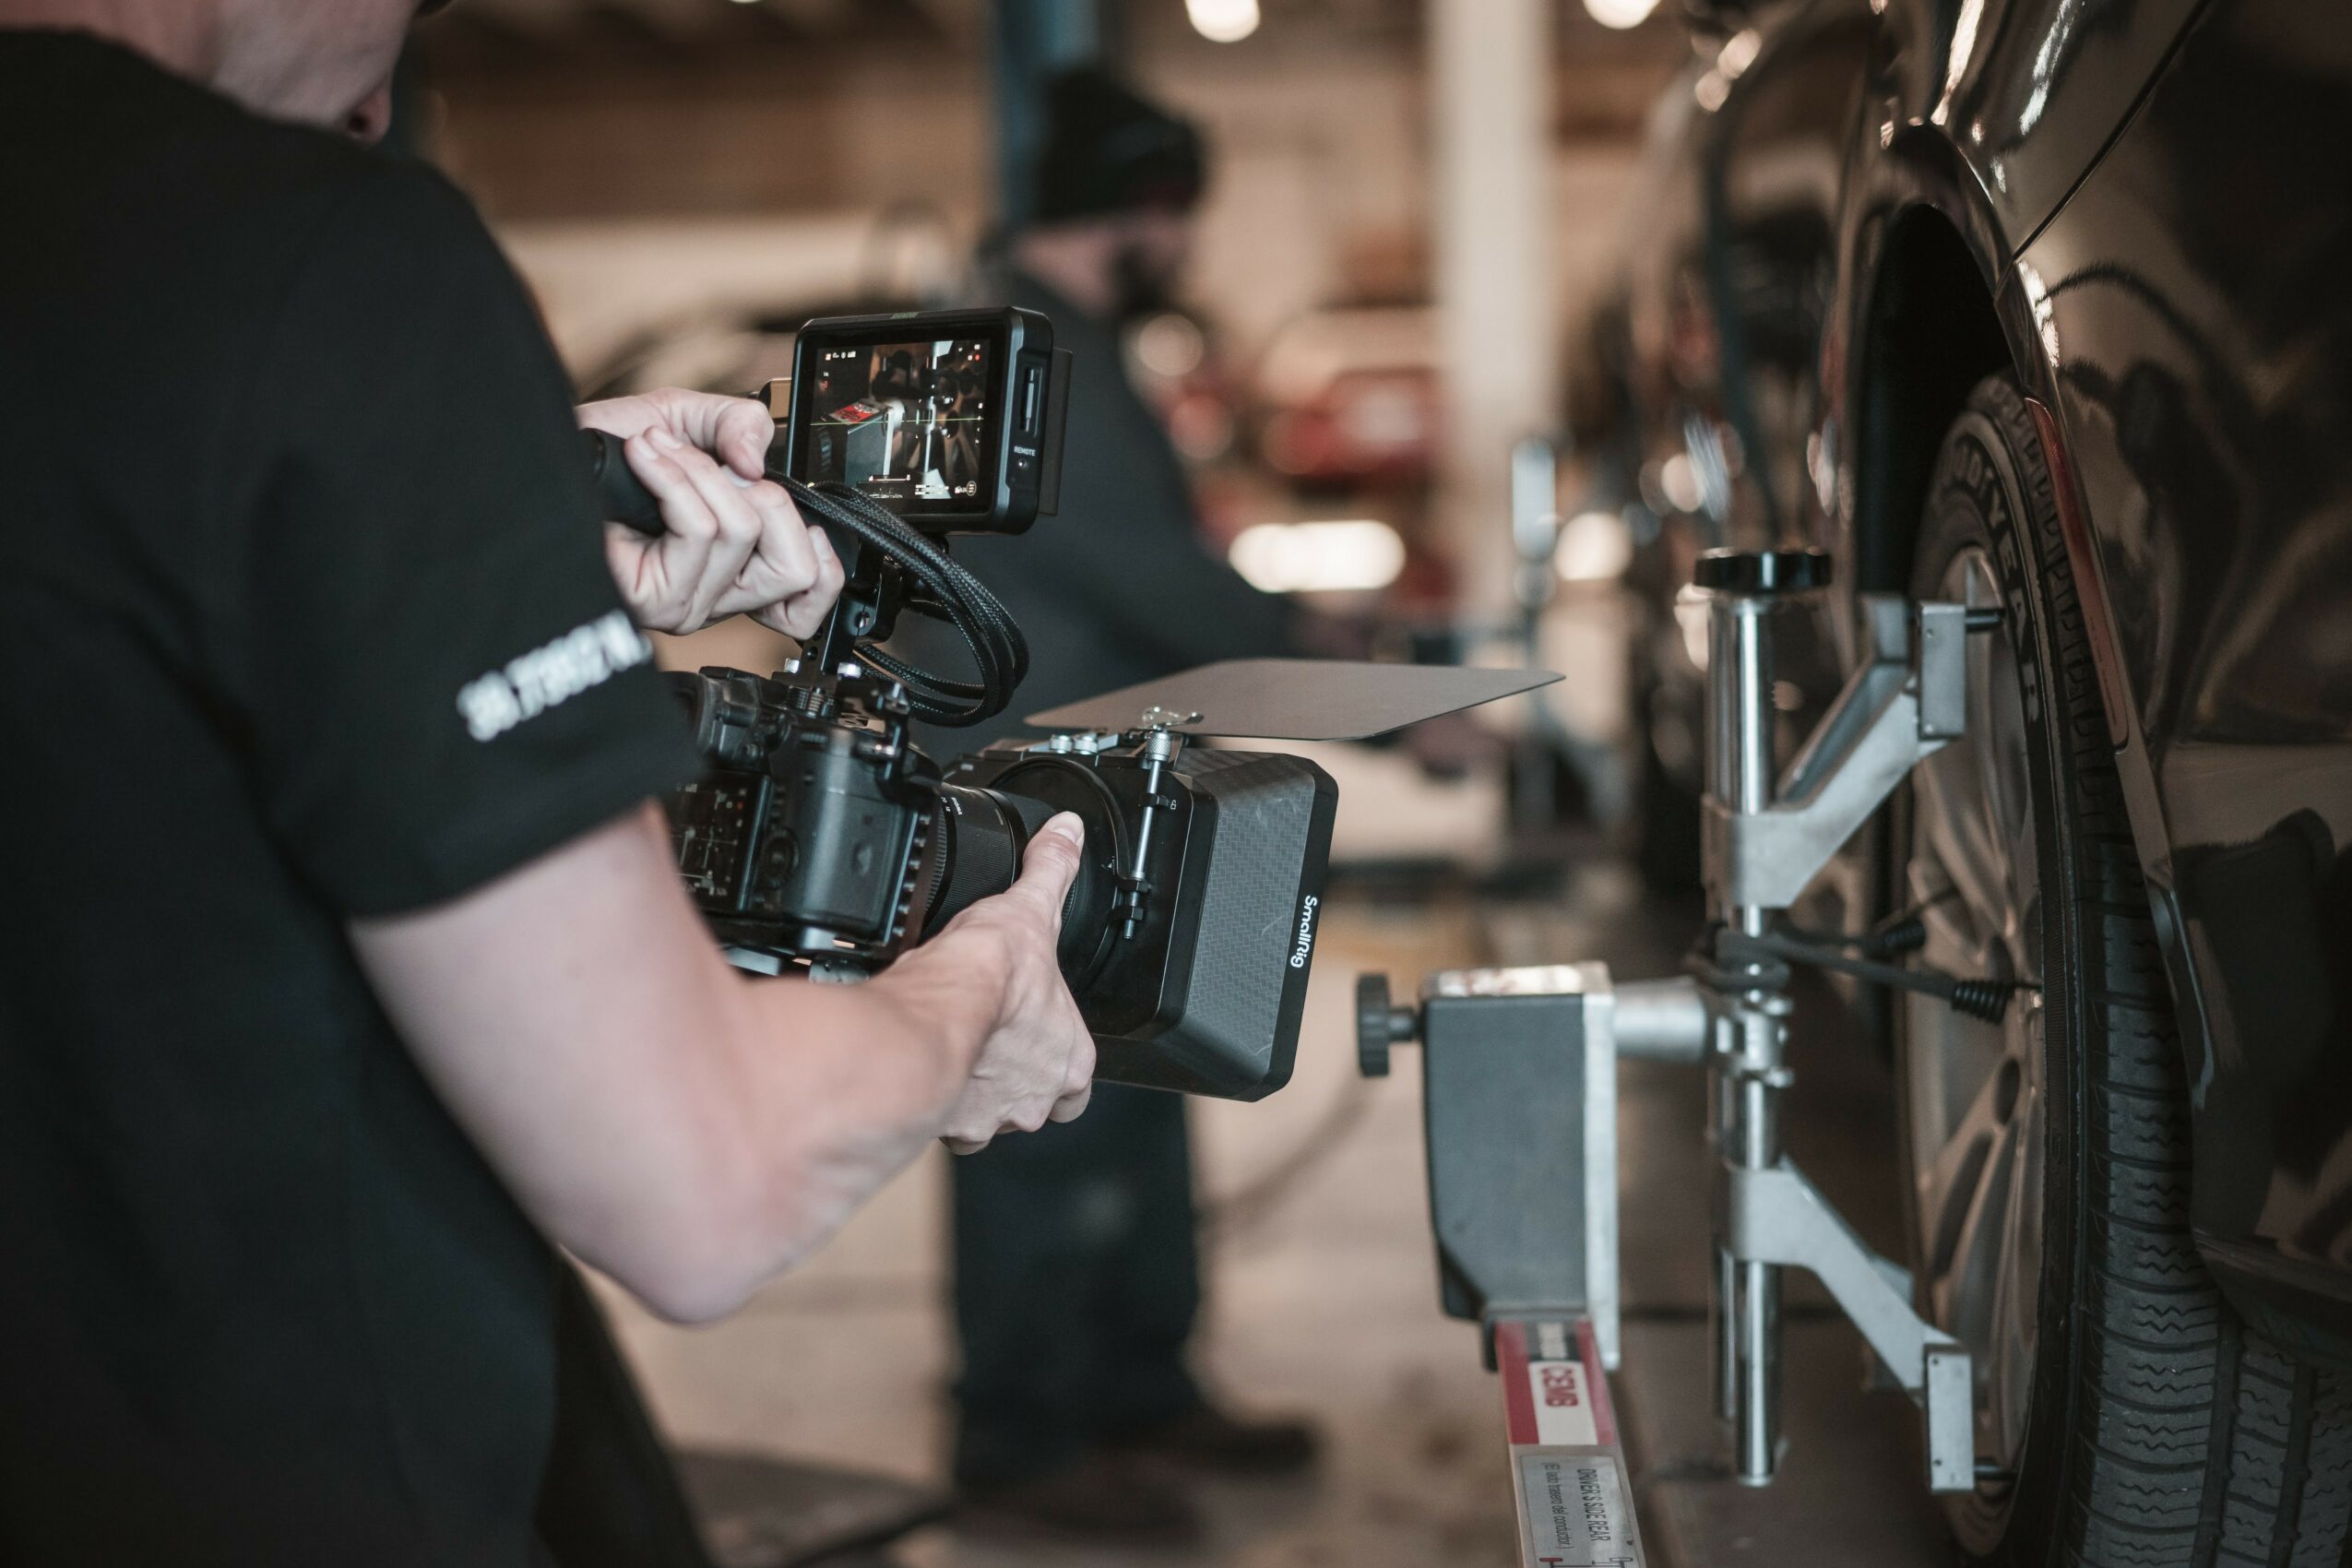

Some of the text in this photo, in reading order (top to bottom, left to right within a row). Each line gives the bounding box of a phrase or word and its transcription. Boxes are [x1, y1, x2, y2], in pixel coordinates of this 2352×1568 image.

[1014, 445, 1036, 457] REMOTE
[1290, 895, 1318, 968] SmallRig
[1540, 1366, 1579, 1408] CEMB
[1548, 1484, 1563, 1504] trasero
[1576, 1468, 1611, 1541] DRIVER'S SIDE REAR
[1551, 1505, 1568, 1515] del
